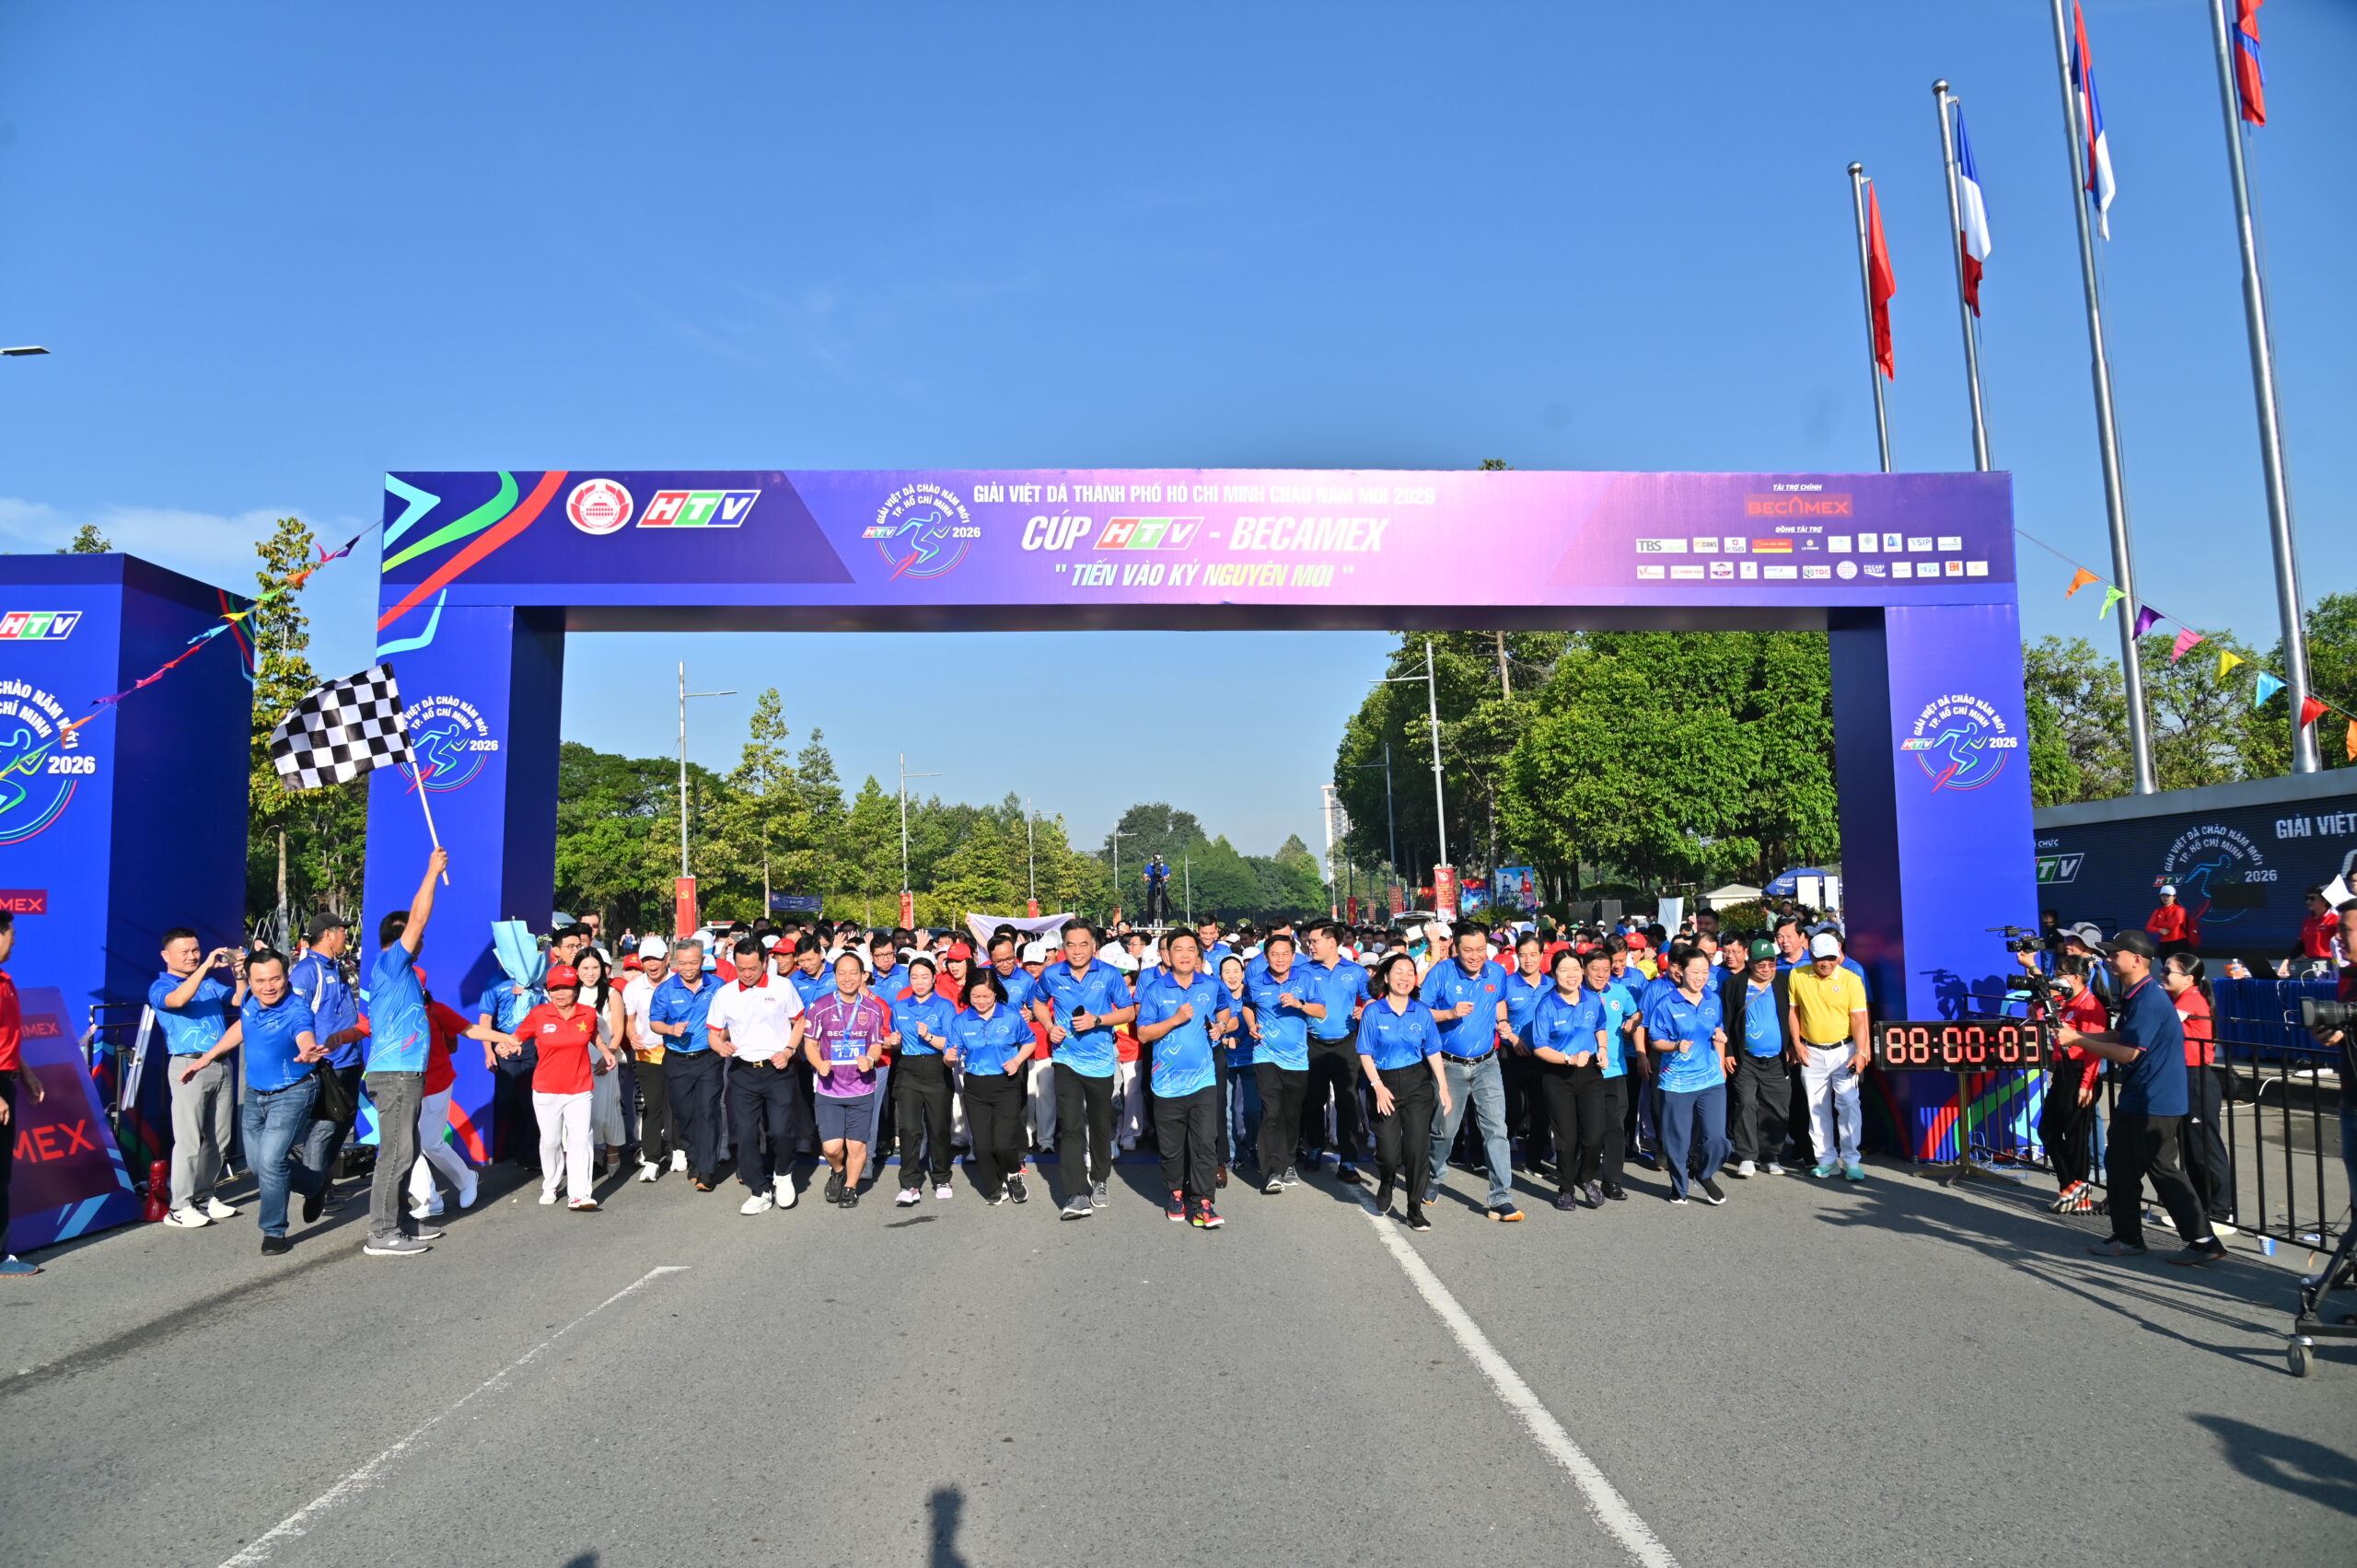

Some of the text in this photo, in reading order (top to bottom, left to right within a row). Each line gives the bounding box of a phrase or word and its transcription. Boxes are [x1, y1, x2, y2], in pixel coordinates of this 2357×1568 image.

[973, 481, 1004, 503] GIẢI
[1009, 482, 1042, 505] VIỆT
[1047, 483, 1068, 503] DÃ
[1074, 482, 1125, 503] THÀNH
[1131, 480, 1163, 503] PHỐ
[1167, 480, 1188, 503] HỒ
[1193, 482, 1219, 503] CHÍ
[1223, 485, 1265, 503] MINH
[1393, 487, 1436, 505] 2026
[642, 495, 757, 523] HTV
[934, 499, 954, 517] MINH
[1748, 496, 1849, 515] BECAMEX
[863, 527, 897, 537] HTV
[952, 527, 981, 538] 2026
[1021, 509, 1092, 551] CÚP
[1098, 521, 1199, 545] HTV
[1228, 517, 1390, 552] BECAMEX
[1638, 540, 1662, 552] TBS
[1072, 558, 1118, 587] TIẾN
[1123, 560, 1166, 587] VÀO
[1167, 558, 1201, 587] KỶ
[0, 614, 78, 636] HTV
[32, 689, 64, 720] NĂM
[18, 705, 53, 738] MINH
[452, 712, 473, 730] MINH
[1968, 709, 1990, 728] MINH
[470, 740, 499, 751] 2026
[1902, 739, 1934, 749] HTV
[1989, 737, 2018, 748] 2026
[48, 756, 95, 774] 2026
[2276, 811, 2357, 839] GIẢI VIỆT
[2038, 839, 2059, 847] CHỨC
[2036, 856, 2081, 881] TV
[2244, 869, 2277, 882] 2026
[2154, 875, 2184, 885] HTV
[838, 1048, 859, 1058] 770
